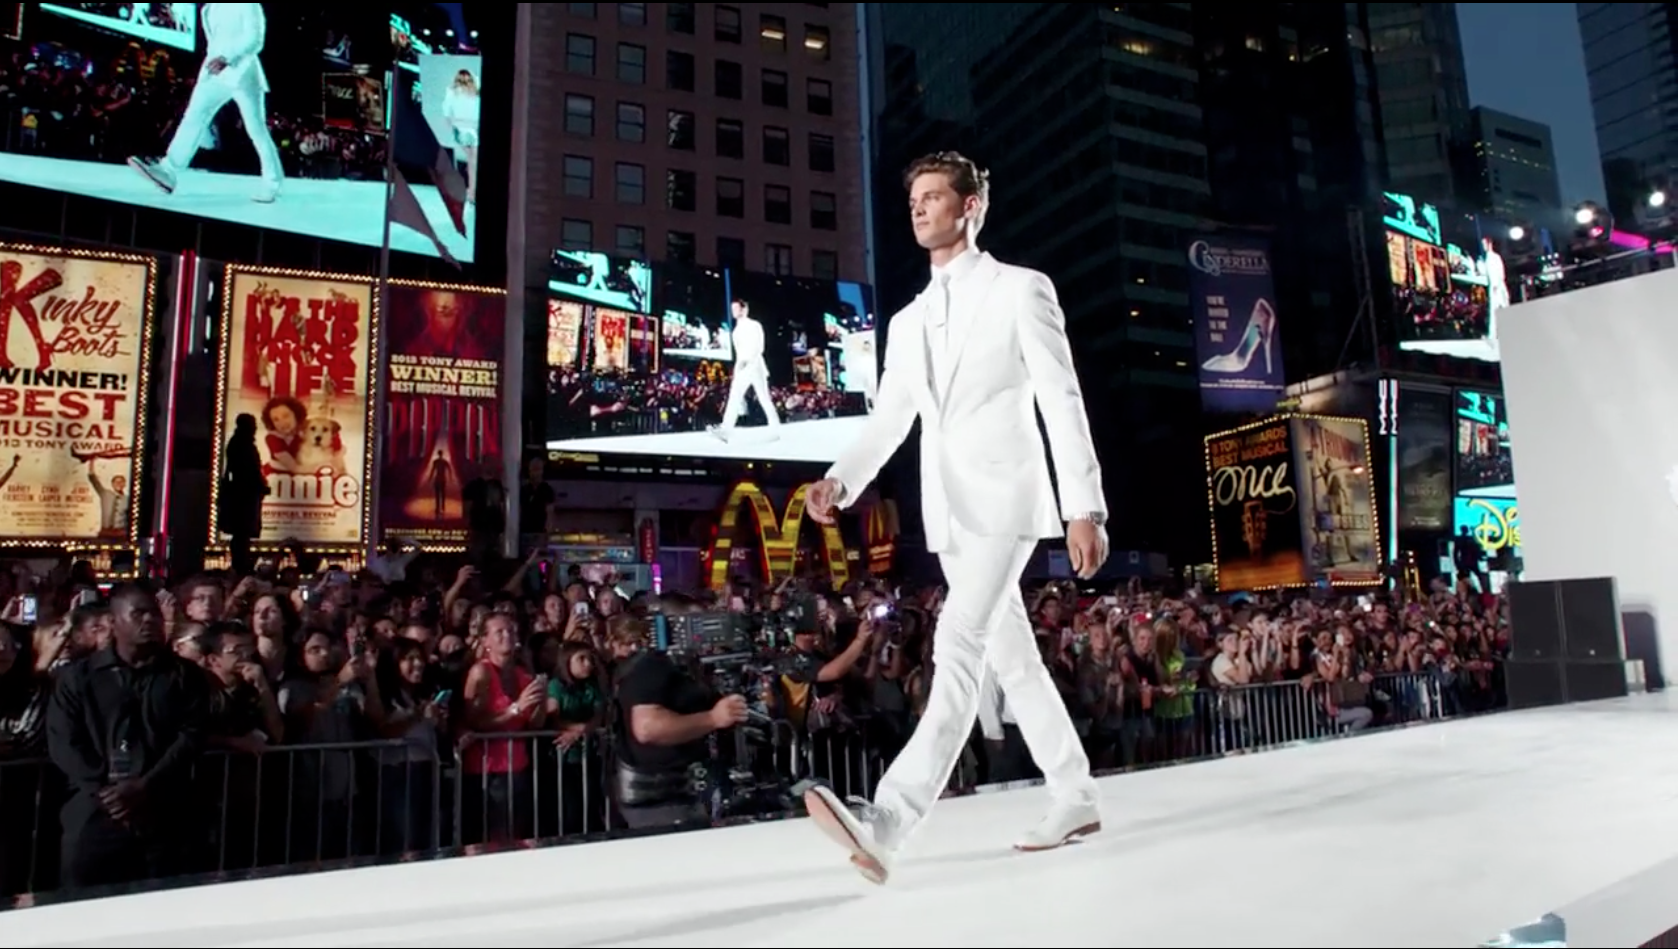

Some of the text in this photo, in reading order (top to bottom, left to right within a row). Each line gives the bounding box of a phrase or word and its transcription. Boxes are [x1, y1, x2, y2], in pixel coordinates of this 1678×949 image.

[51, 326, 131, 358] Boots
[420, 355, 453, 367] TONY
[454, 358, 498, 370] AWARD
[0, 367, 127, 391] WINNER!
[390, 364, 497, 386] WINNER!
[390, 381, 497, 399] BEST MUSICAL REVIVAL
[0, 387, 127, 421] BEST
[24, 440, 67, 449] TONY
[261, 464, 359, 508] nnie
